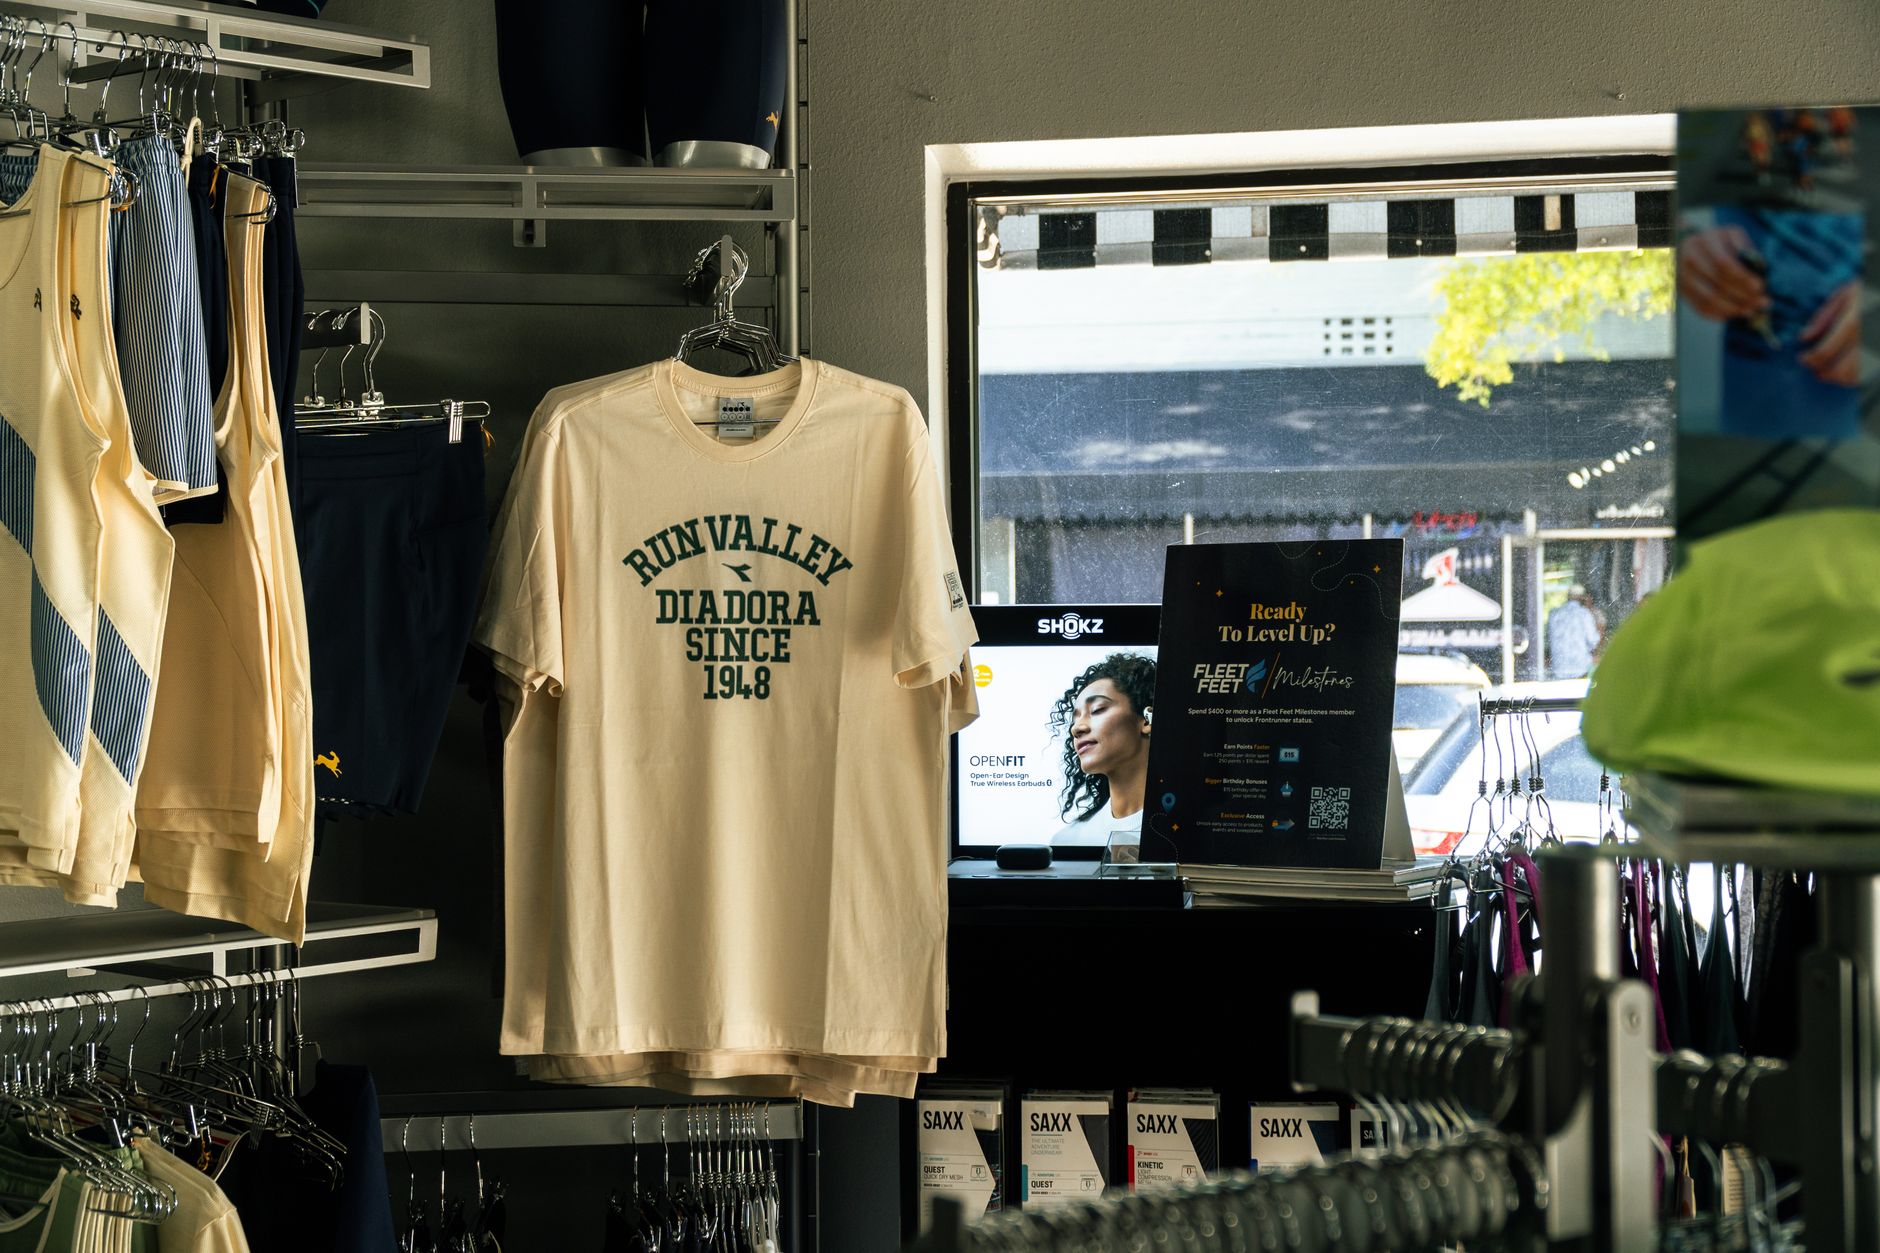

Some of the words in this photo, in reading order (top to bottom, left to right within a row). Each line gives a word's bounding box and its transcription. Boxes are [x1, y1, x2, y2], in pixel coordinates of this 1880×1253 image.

[656, 589, 821, 626] DIADORA
[1250, 602, 1307, 622] Ready
[1038, 617, 1104, 634] SHOKZ
[1218, 625, 1242, 642] To
[1246, 624, 1294, 642] Level
[1300, 623, 1336, 645] Up?
[686, 627, 791, 663] SINCE
[1193, 663, 1250, 679] FLEET
[1272, 666, 1354, 693] Milestones
[703, 664, 771, 700] 1948
[1197, 678, 1244, 694] FEET
[970, 755, 1026, 766] OPENFIT
[923, 1110, 964, 1131] SAXX
[1030, 1112, 1072, 1132] SAXX
[1136, 1114, 1178, 1134] SAXX
[1260, 1118, 1303, 1138] SAXX
[924, 1165, 945, 1174] QUEST
[1137, 1161, 1164, 1169] KINETIC
